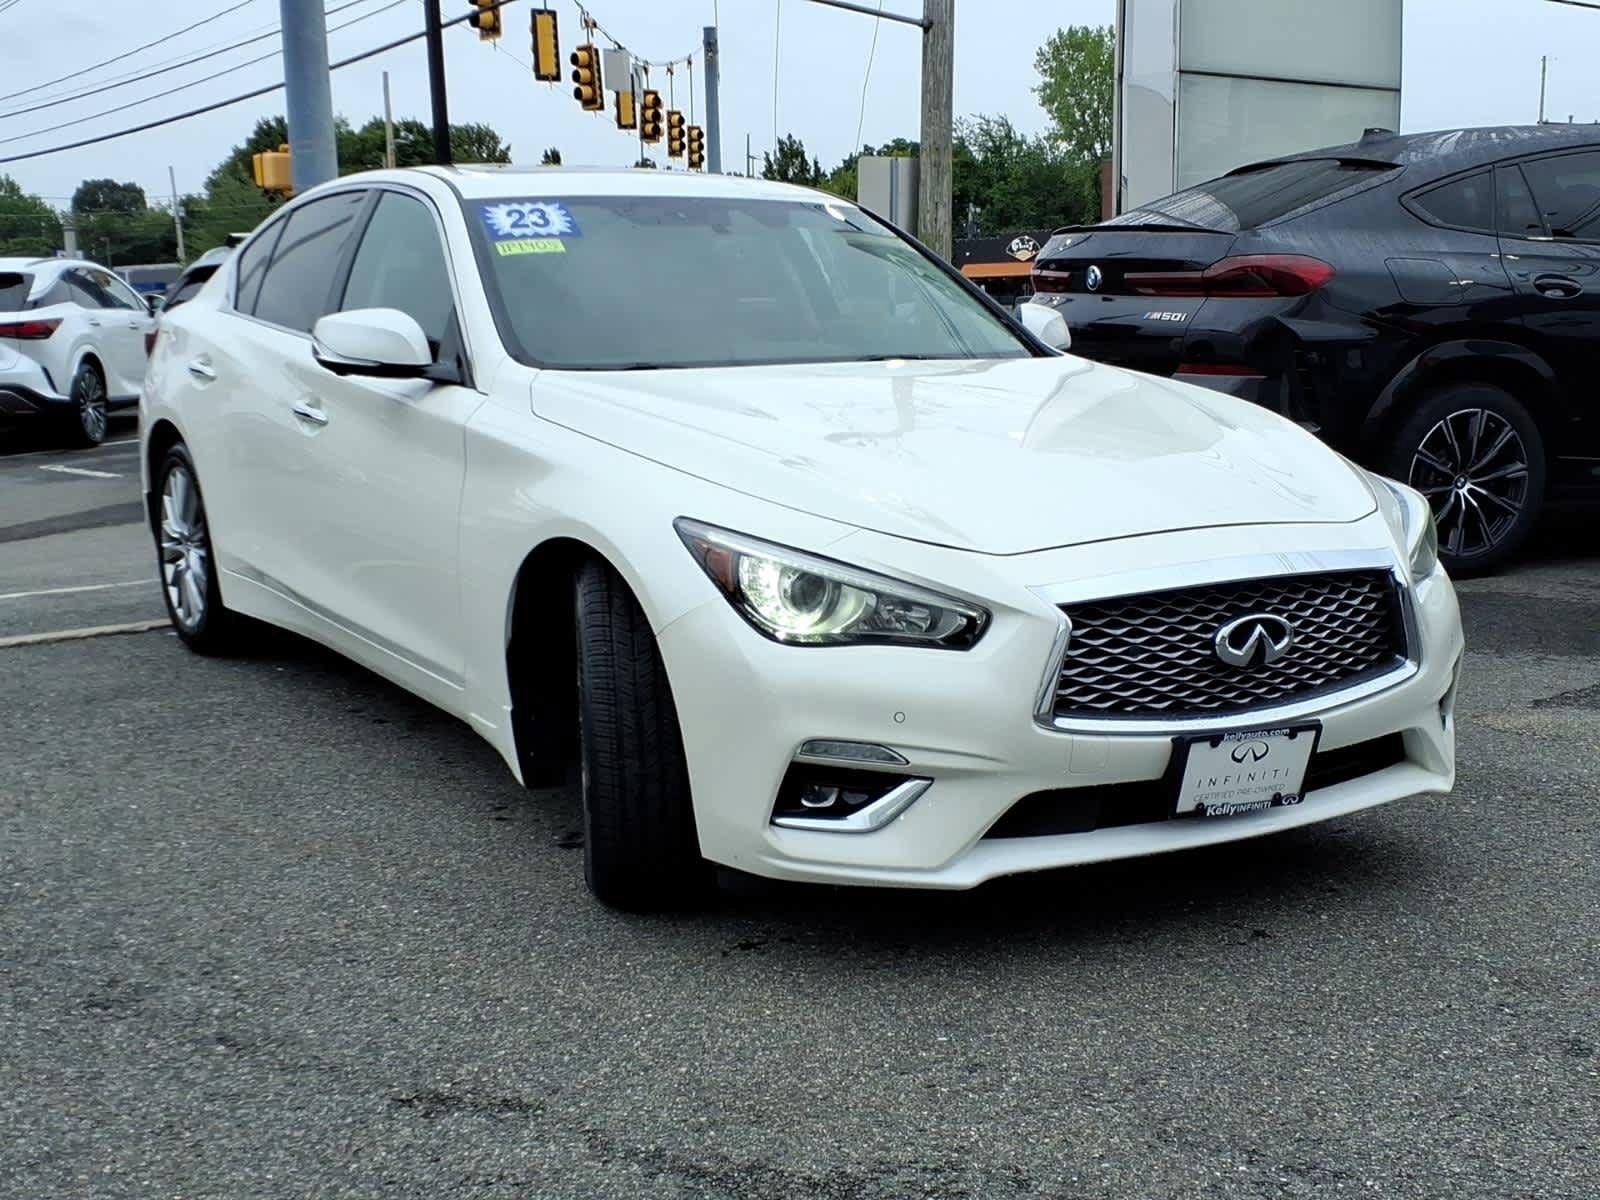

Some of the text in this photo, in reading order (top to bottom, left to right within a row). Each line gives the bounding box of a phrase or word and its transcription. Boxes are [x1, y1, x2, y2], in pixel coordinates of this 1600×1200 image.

[506, 207, 551, 228] 23
[1223, 728, 1291, 742] kellyauto.com
[1197, 767, 1290, 788] INFINITI
[1193, 783, 1286, 802] CERTIFIED PRE-OWNED
